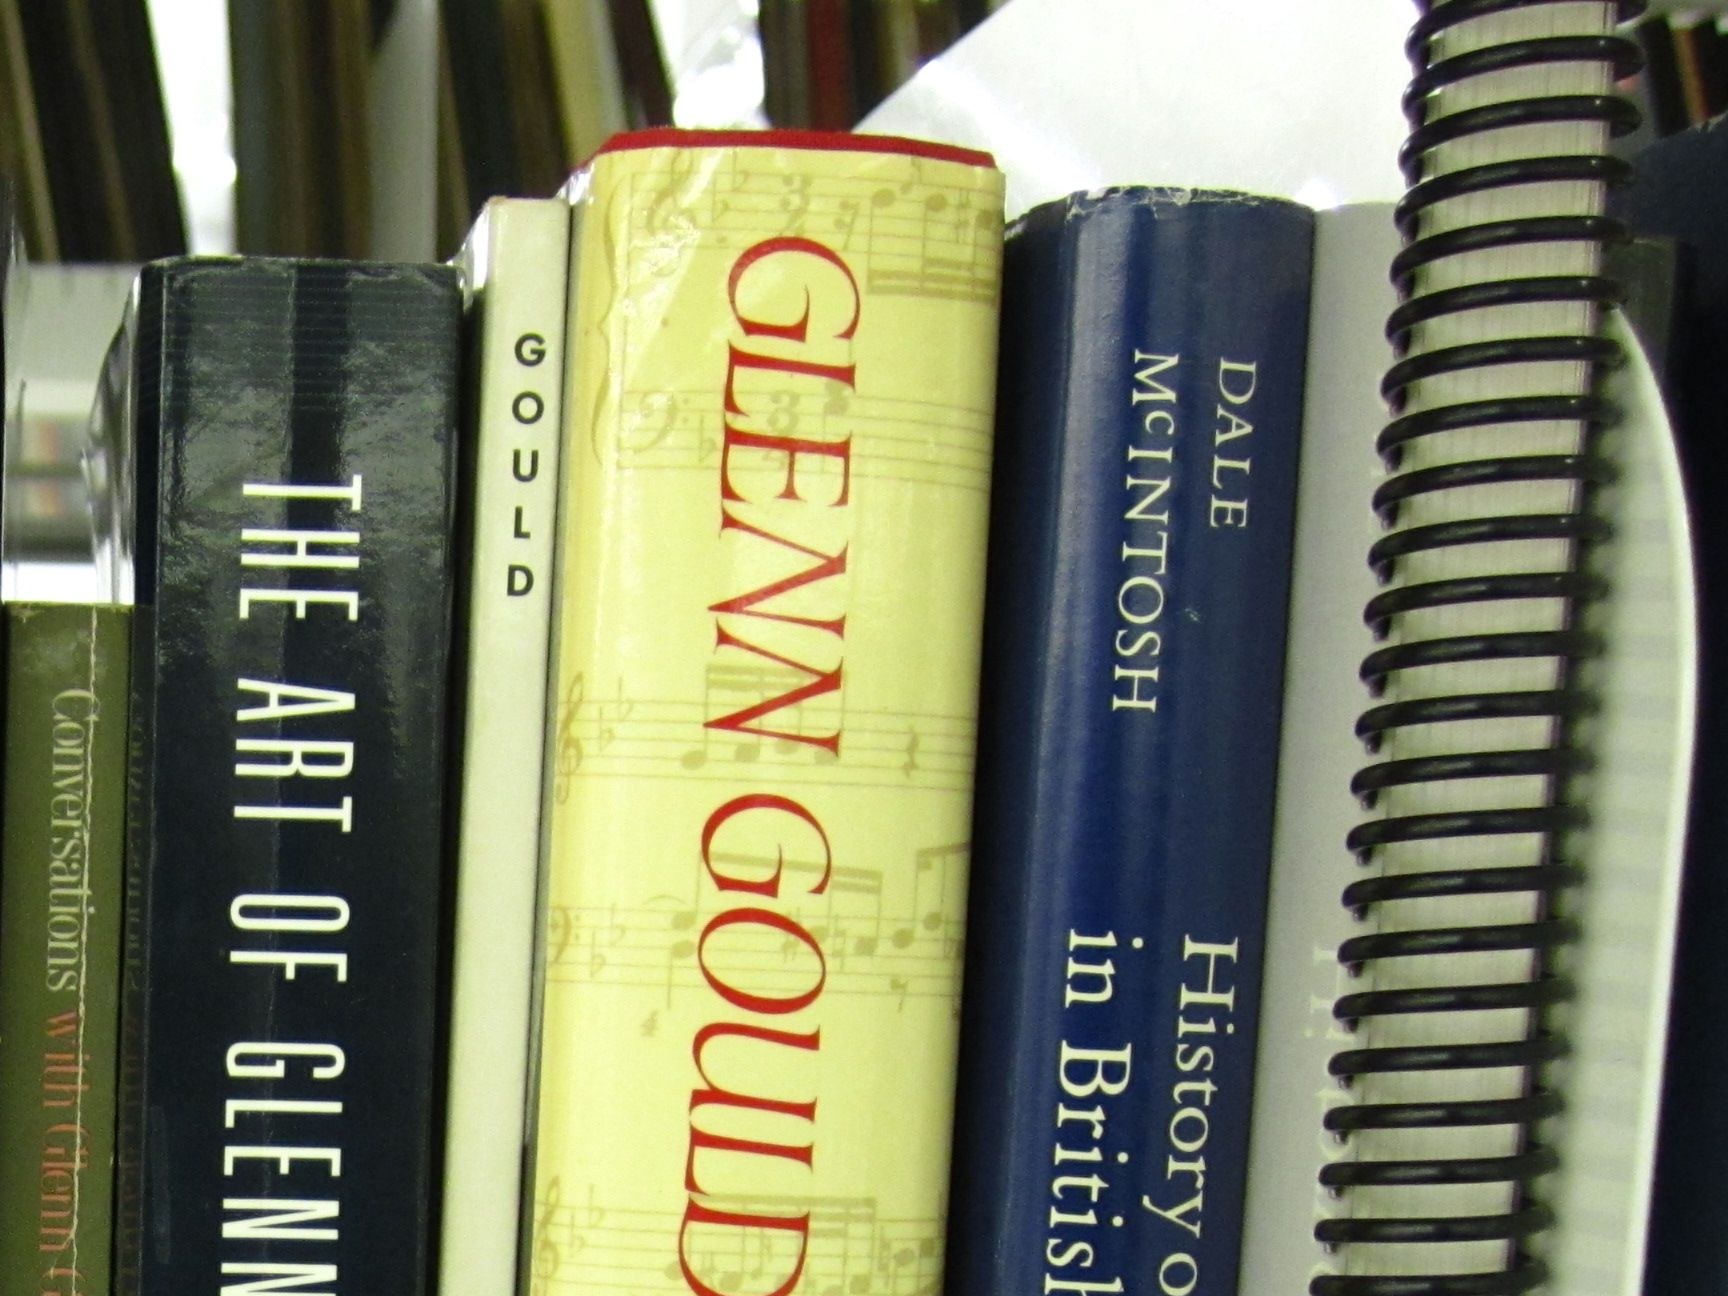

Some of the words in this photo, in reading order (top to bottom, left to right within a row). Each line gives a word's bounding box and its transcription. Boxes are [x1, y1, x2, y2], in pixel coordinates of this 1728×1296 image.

[507, 334, 547, 597] GOULD
[704, 236, 860, 759] GLENN
[1210, 359, 1257, 529] DALE
[239, 474, 363, 623] THE
[1112, 348, 1179, 713] McINTOSH
[233, 678, 356, 833] ART
[45, 686, 100, 993] Conversations
[230, 894, 350, 982] OF
[1066, 928, 1144, 1006] in
[42, 1009, 89, 1110] with
[1144, 934, 1238, 1238] History
[37, 1120, 91, 1254] Glenn
